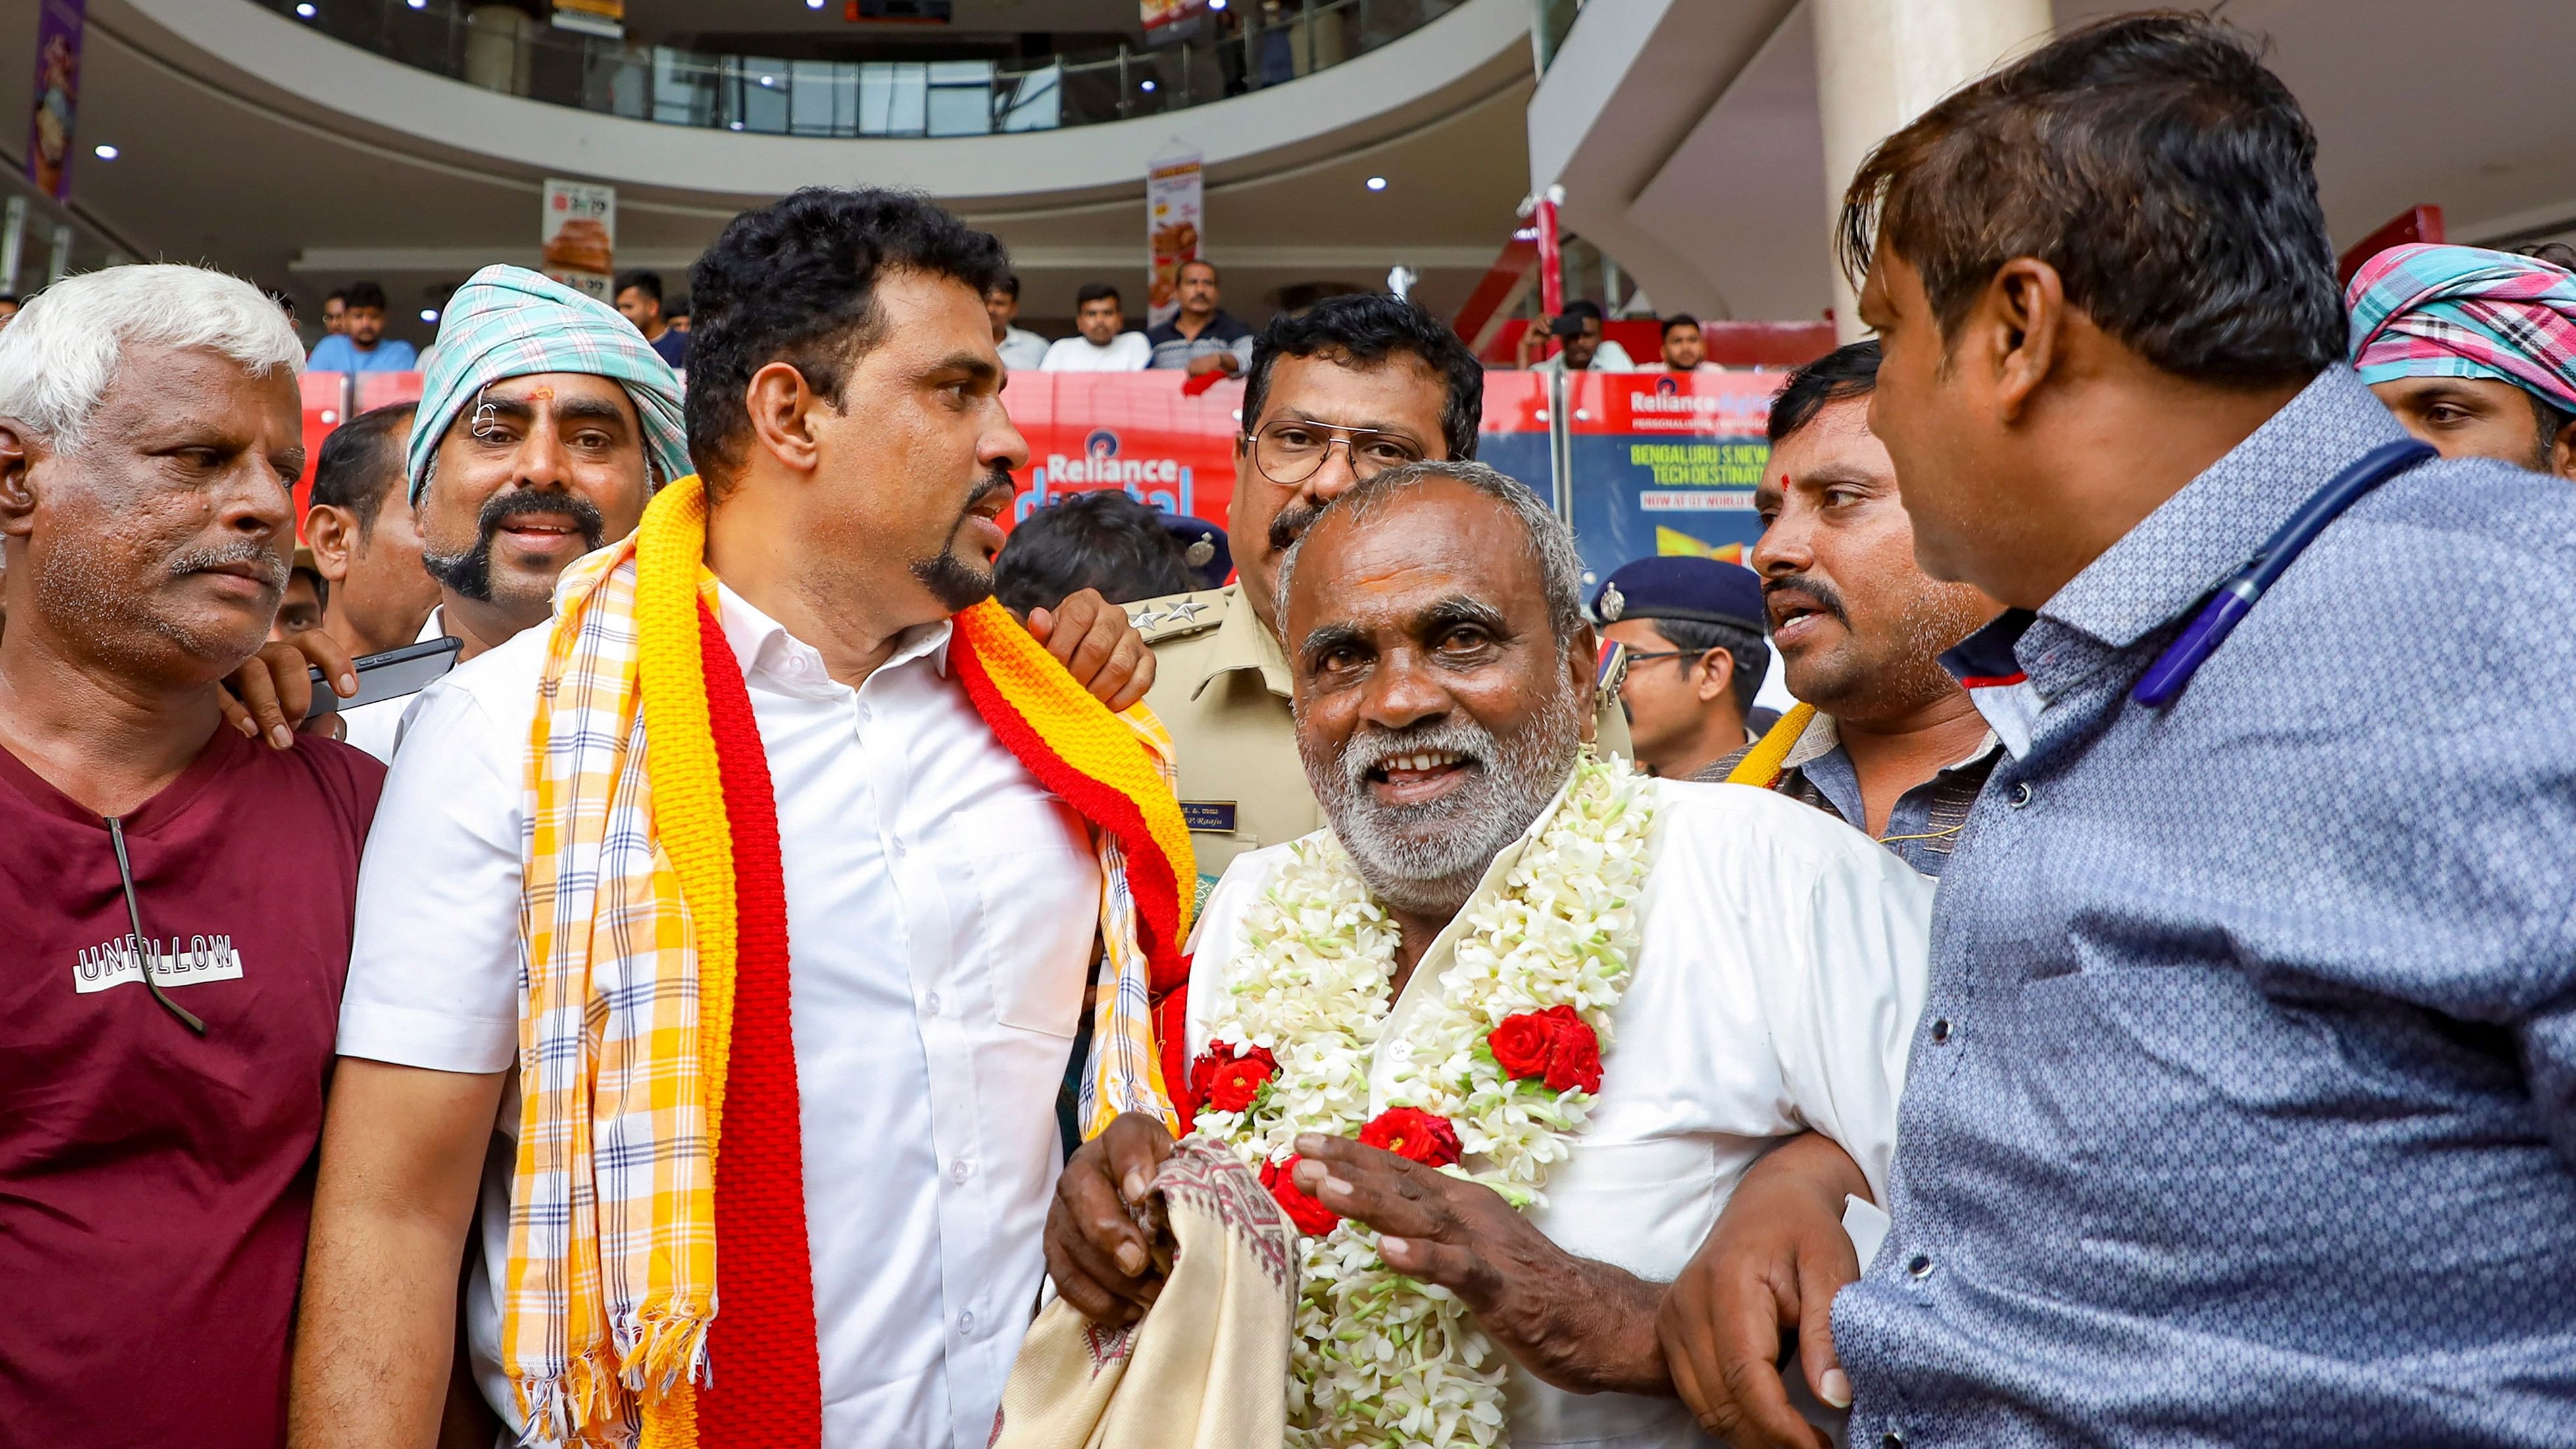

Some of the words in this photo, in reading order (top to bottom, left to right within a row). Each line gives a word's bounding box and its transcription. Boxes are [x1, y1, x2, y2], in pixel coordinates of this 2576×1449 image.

[1631, 391, 1715, 412] Reliance
[1733, 444, 1770, 464] NEW
[1046, 453, 1179, 483] Reliance
[1653, 464, 1689, 485] TECH
[1644, 495, 1670, 506] NOW
[1674, 495, 1685, 506] AT
[1705, 495, 1745, 506] WORLD
[78, 933, 234, 981] UNFOLLOW
